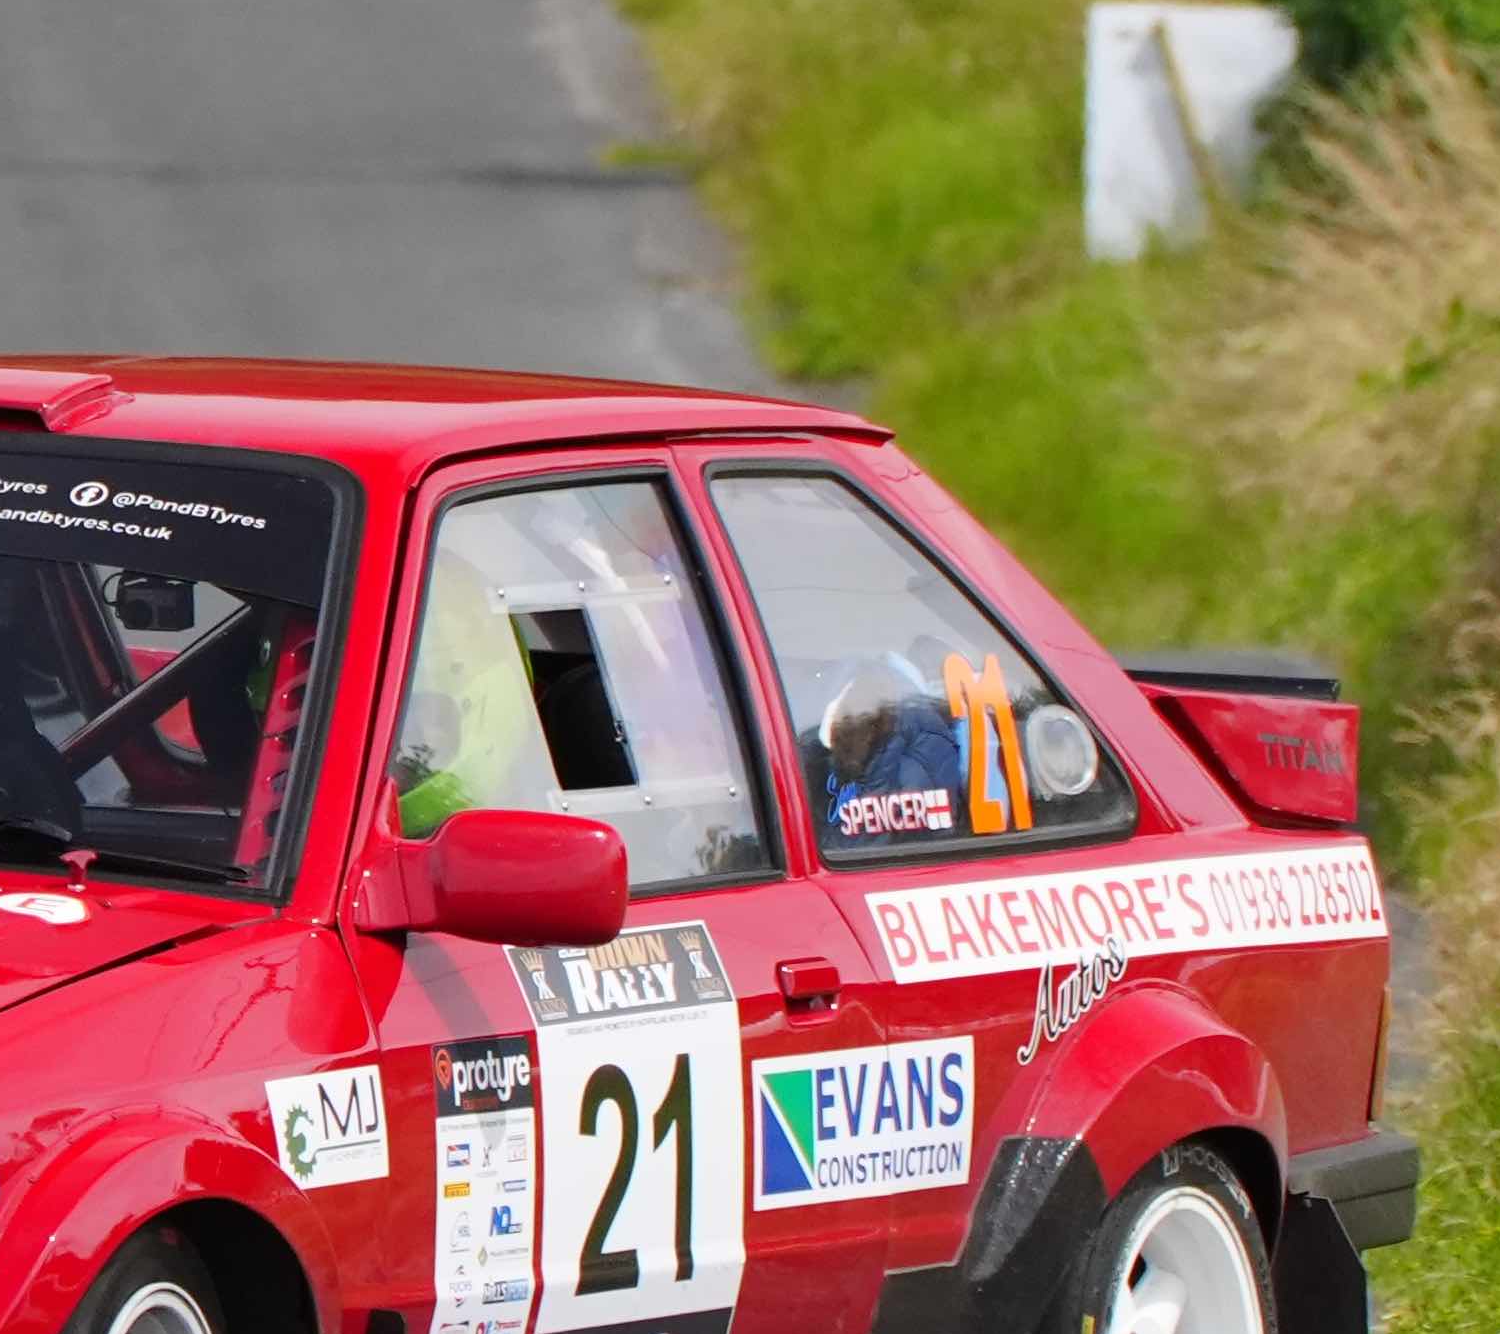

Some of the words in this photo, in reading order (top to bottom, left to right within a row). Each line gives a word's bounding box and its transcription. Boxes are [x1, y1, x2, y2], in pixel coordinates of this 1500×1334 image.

[112, 491, 267, 530] @PandBTyres
[943, 652, 1033, 835] 21
[838, 788, 928, 836] SPENCER
[876, 872, 1210, 969] BLAKEMORE'S
[1208, 868, 1291, 935] 01938
[1287, 859, 1381, 927] 228502
[562, 962, 678, 1014] RALLY
[1016, 930, 1127, 1065] Autos
[451, 1050, 531, 1107] protyre
[815, 1052, 964, 1141] EVANS
[574, 1053, 694, 1297] 21
[817, 1141, 963, 1188] CONSTRUCTION
